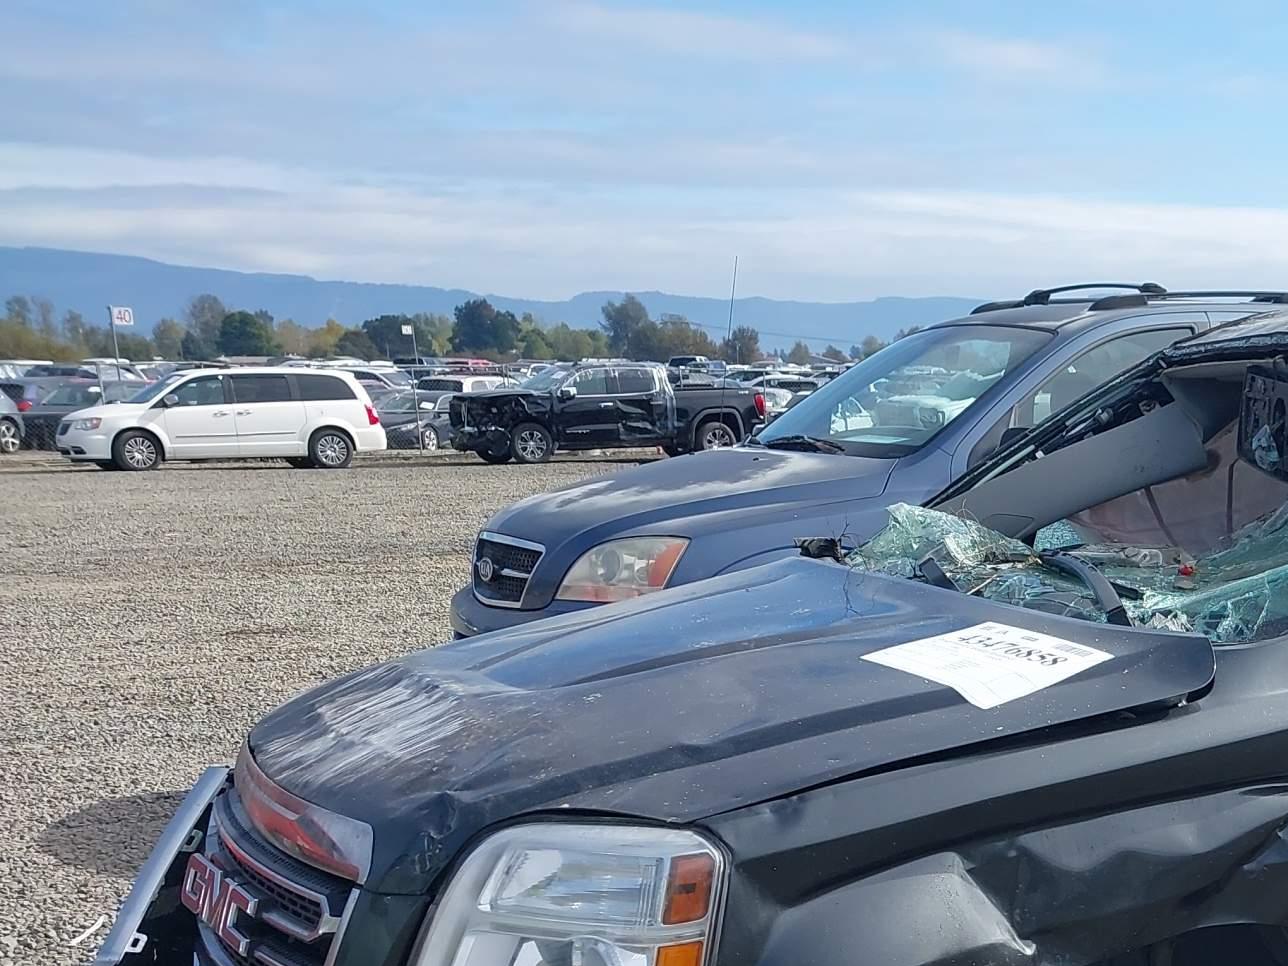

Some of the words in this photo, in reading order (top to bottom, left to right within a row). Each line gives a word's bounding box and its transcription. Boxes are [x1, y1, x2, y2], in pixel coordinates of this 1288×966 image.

[116, 309, 131, 322] 40
[959, 635, 1068, 666] 43476858
[181, 853, 258, 957] GMC
